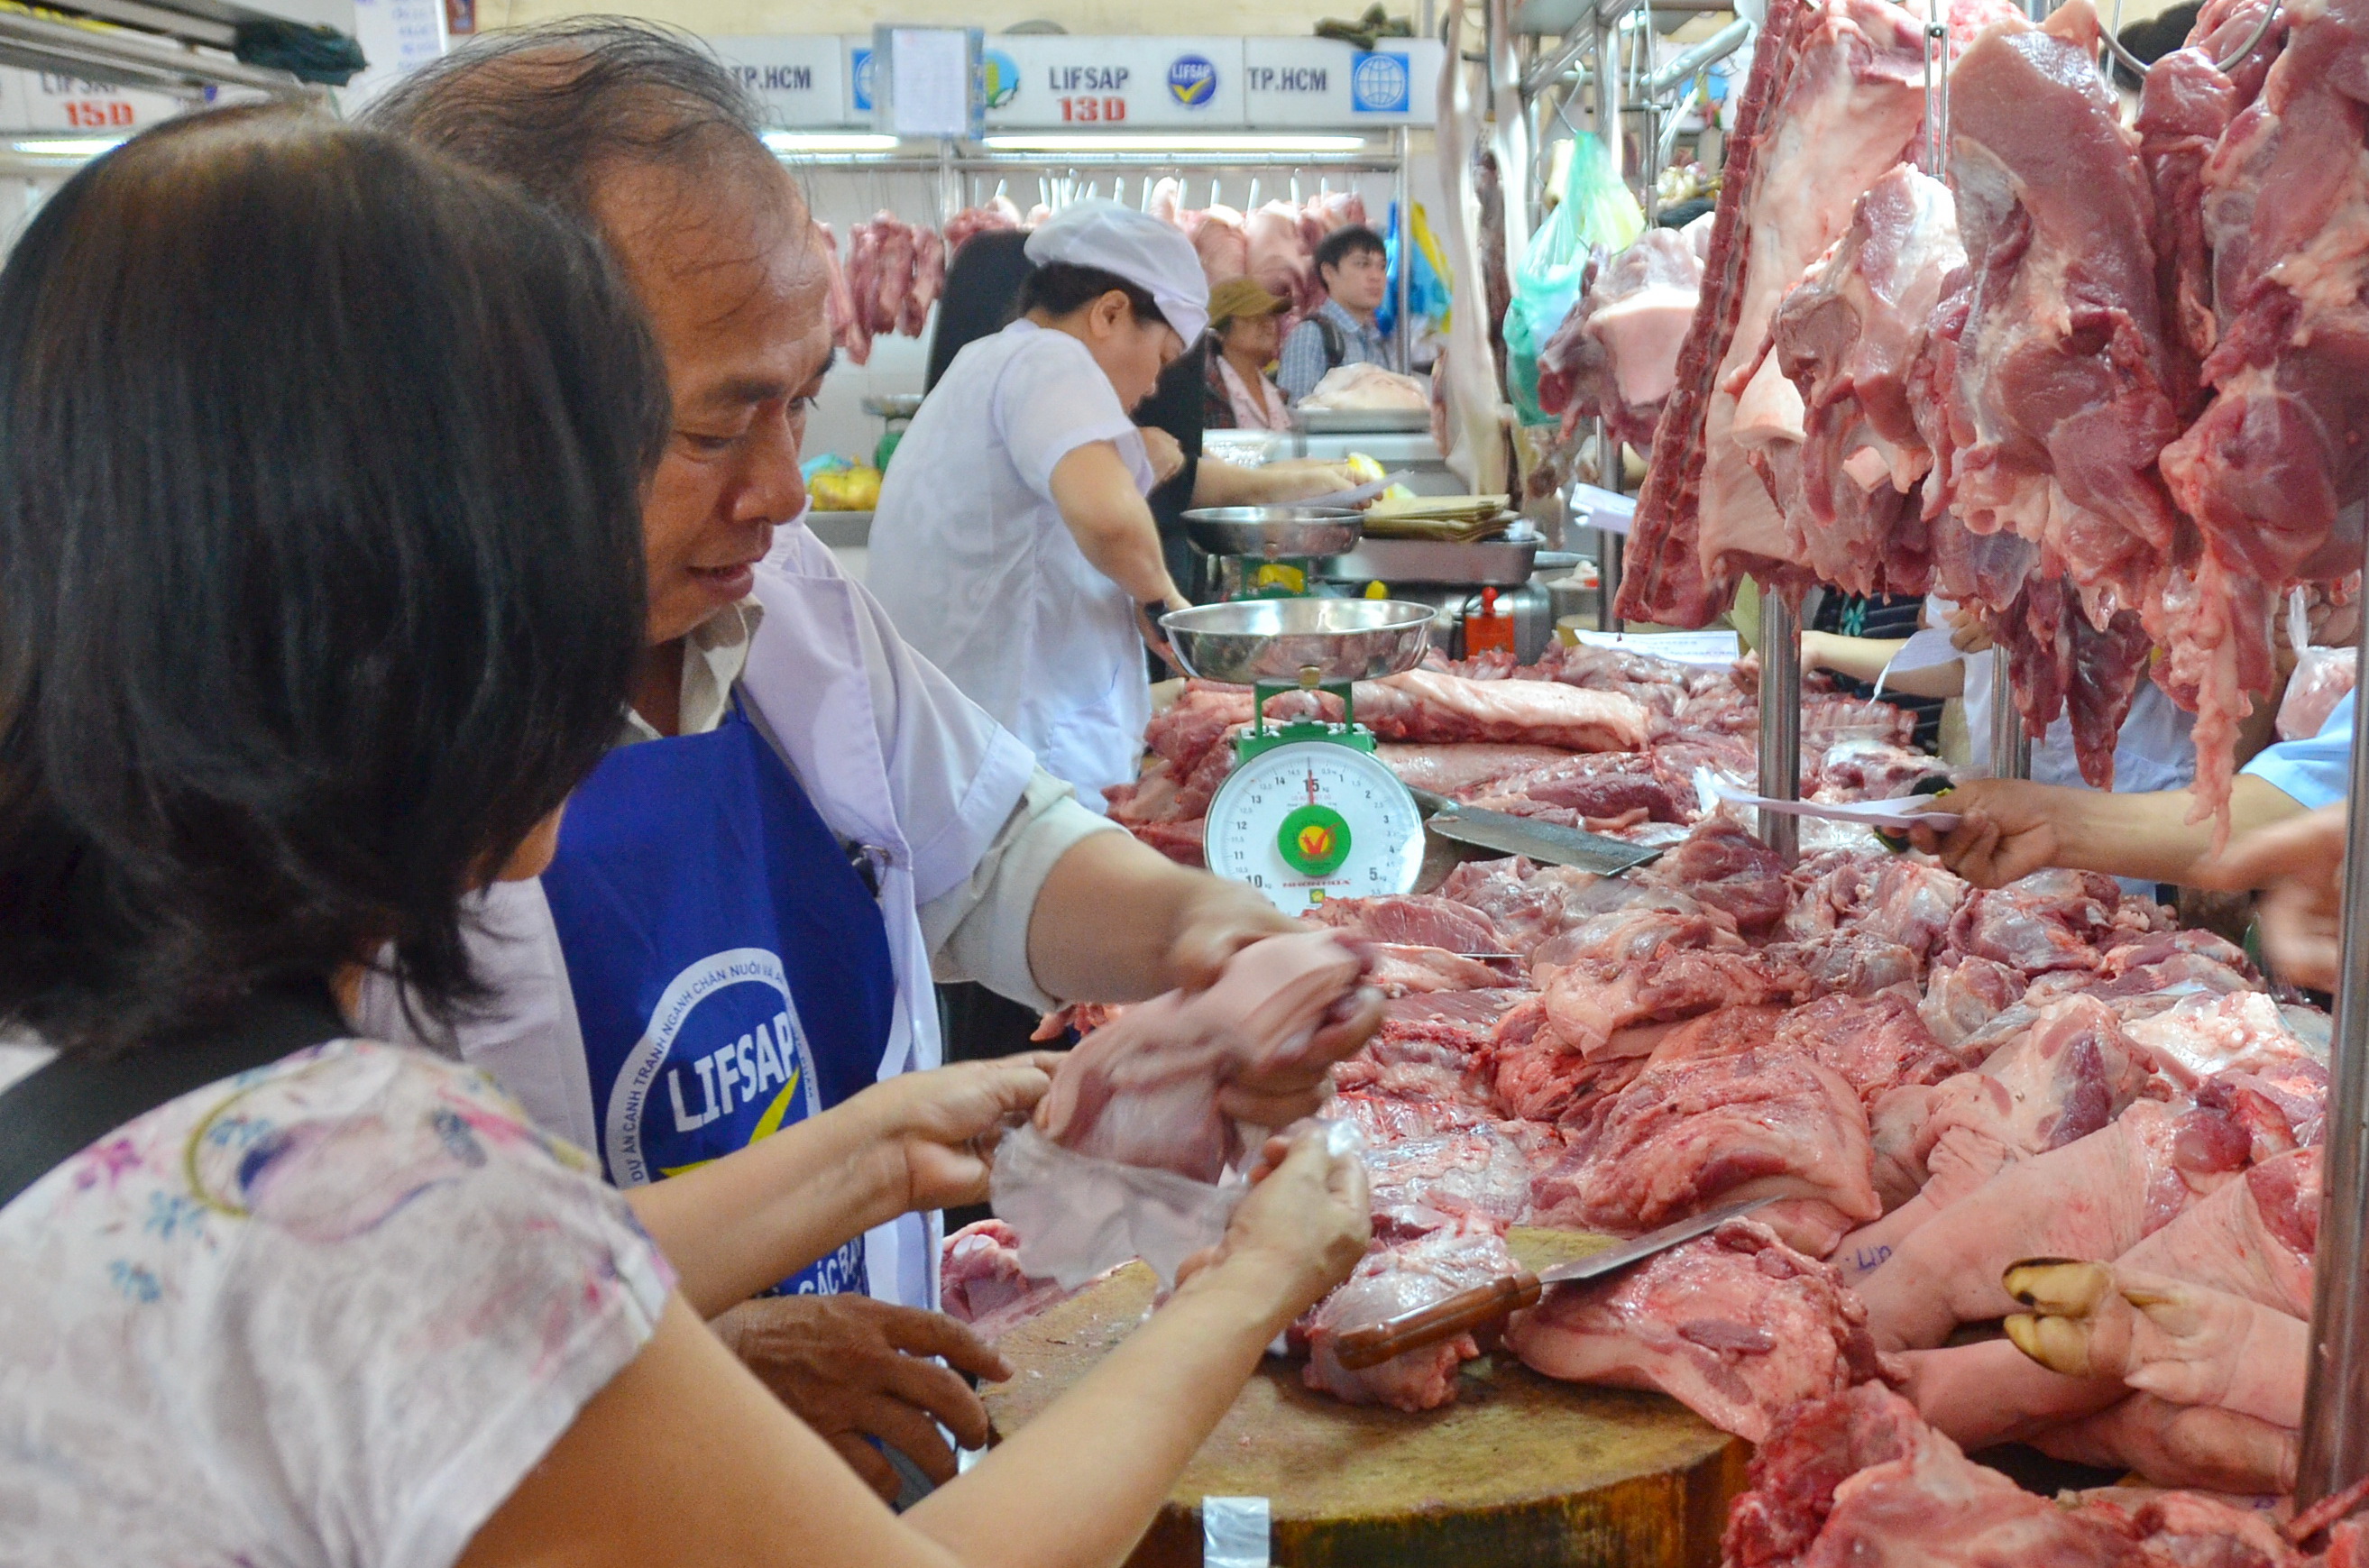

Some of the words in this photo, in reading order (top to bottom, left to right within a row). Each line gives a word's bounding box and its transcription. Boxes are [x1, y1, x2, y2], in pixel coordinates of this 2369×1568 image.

[1172, 63, 1211, 78] LIFSAP
[1050, 67, 1128, 89] LIFSAP
[1248, 67, 1327, 90] TP.HCM
[1275, 776, 1286, 784] 14
[1303, 778, 1319, 793] 15
[1252, 795, 1262, 803] 13
[1365, 790, 1371, 799] 2
[1236, 821, 1246, 830] 12
[1383, 815, 1389, 823] 3
[1235, 851, 1244, 859] 11
[1390, 845, 1394, 854] 4
[1369, 867, 1377, 881] 5
[1245, 875, 1263, 888] 10
[634, 1037, 666, 1086] TRANH
[667, 1011, 794, 1132] LIFSAP
